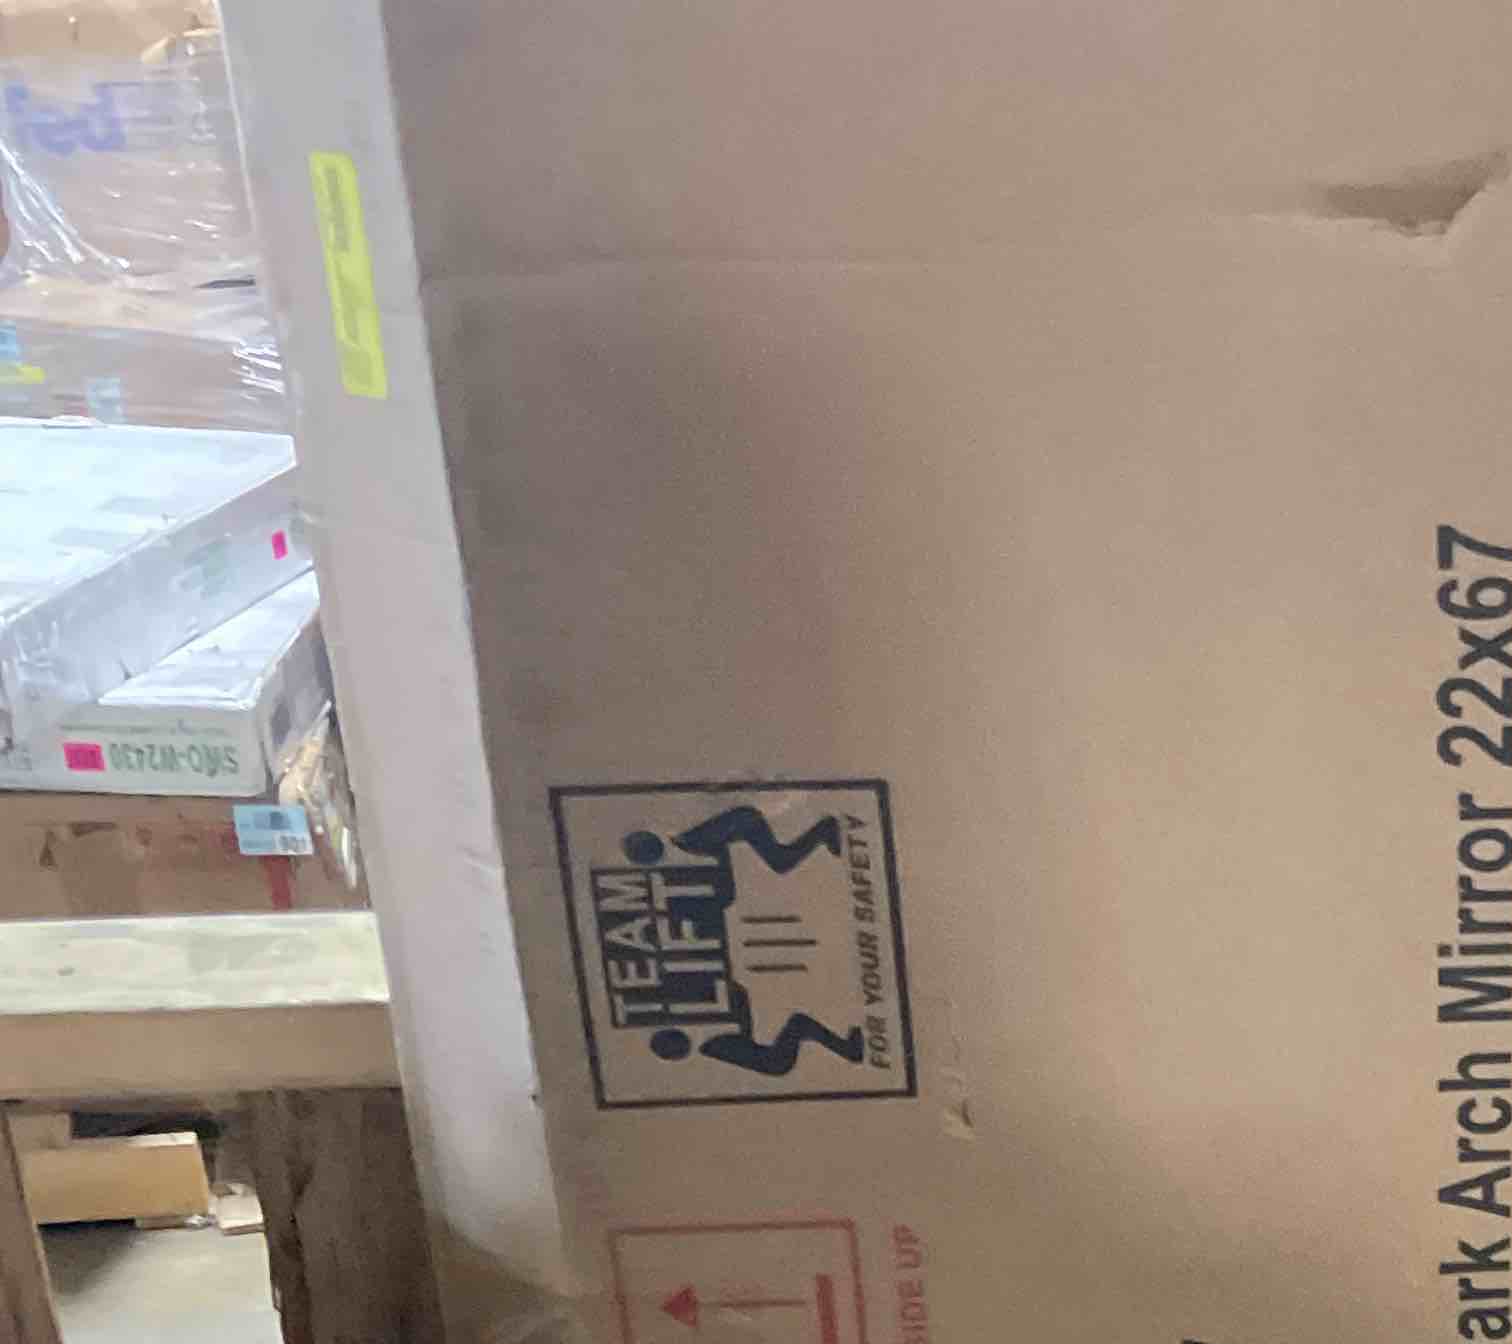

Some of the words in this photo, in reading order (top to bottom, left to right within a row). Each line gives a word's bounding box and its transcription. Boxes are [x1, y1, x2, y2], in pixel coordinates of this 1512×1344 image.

[842, 813, 880, 925] SAFETY
[594, 870, 663, 1025] TEAM
[650, 870, 732, 1015] LIFT
[857, 933, 887, 1010] YOUR
[865, 1017, 892, 1070] FOR
[893, 1223, 923, 1271] UP
